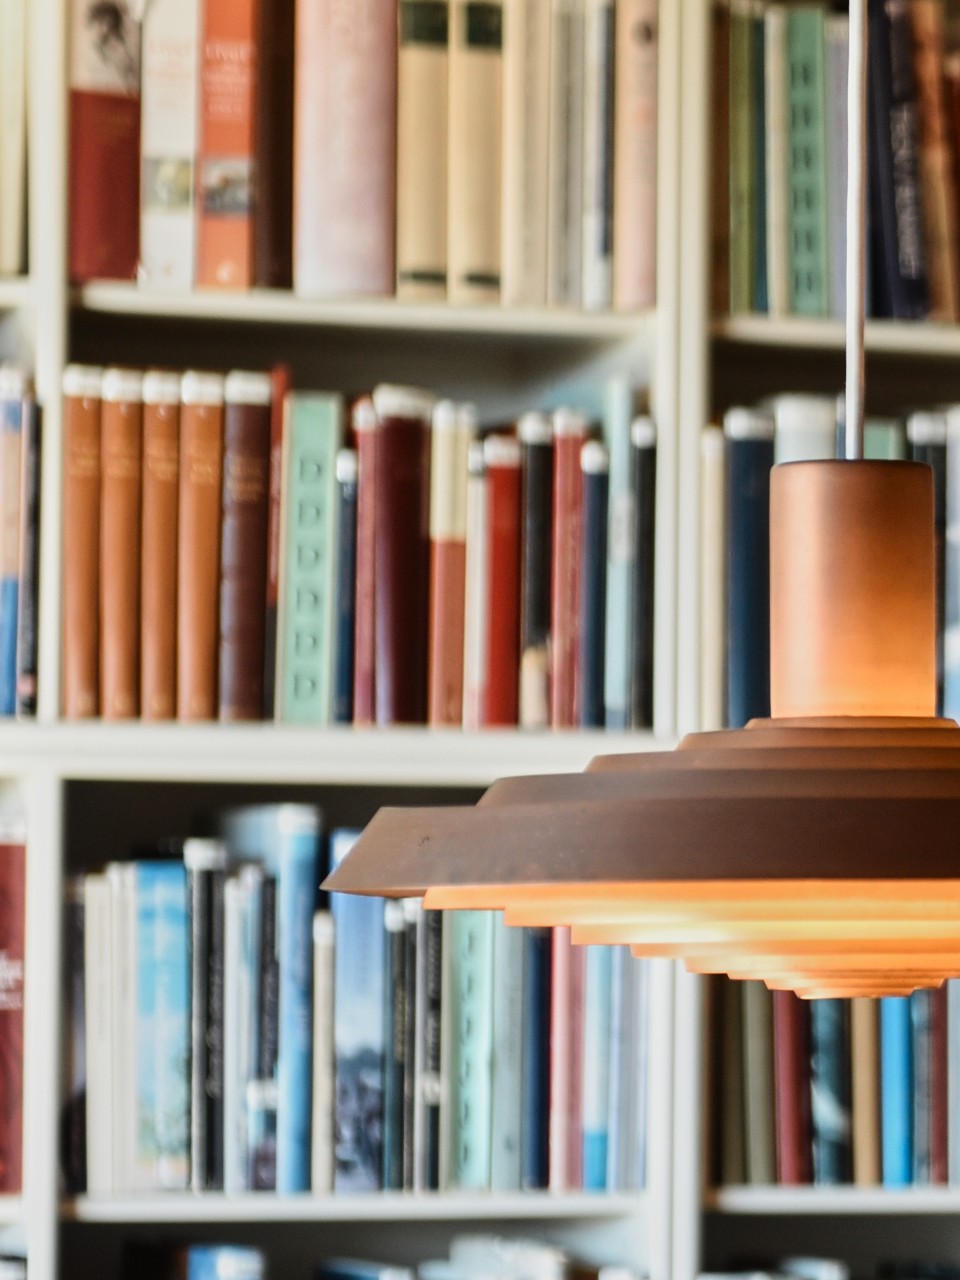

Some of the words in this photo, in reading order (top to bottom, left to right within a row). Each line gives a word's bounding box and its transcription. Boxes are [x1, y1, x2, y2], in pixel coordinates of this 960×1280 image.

[299, 456, 322, 482] D
[298, 499, 321, 526] D
[297, 543, 320, 569] D
[296, 587, 319, 613] D
[295, 630, 318, 656] D
[294, 673, 317, 699] D
